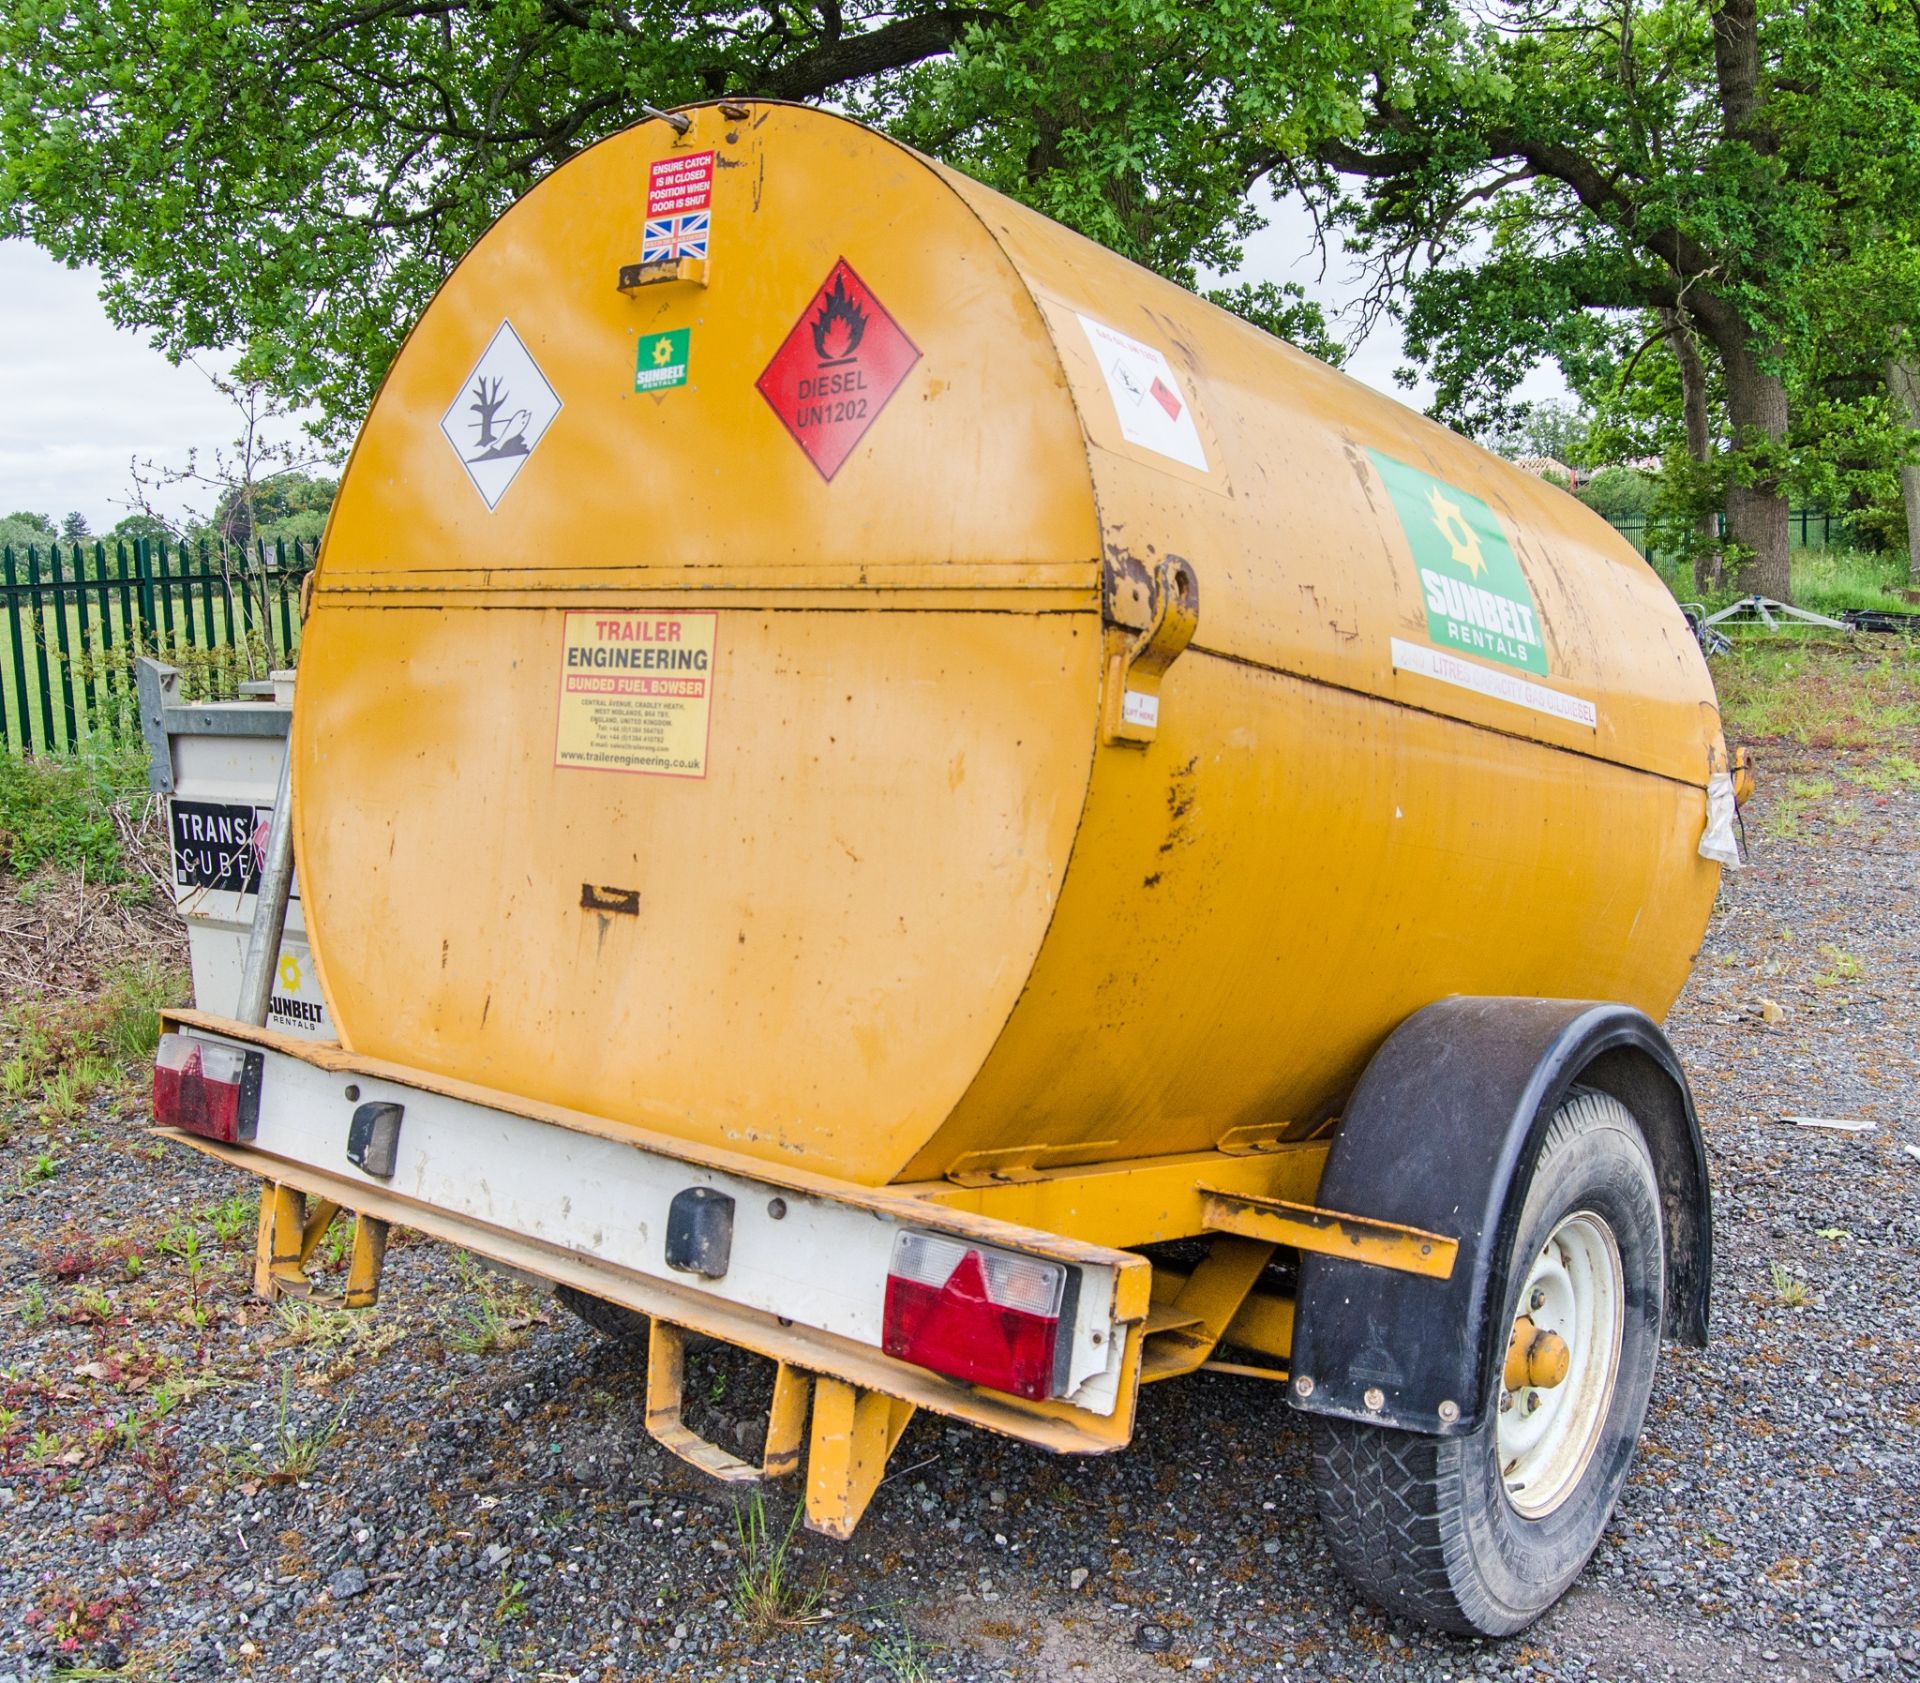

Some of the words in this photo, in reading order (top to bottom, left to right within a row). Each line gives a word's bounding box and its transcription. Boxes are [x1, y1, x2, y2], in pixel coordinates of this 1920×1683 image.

[653, 162, 683, 175] ENSURE
[685, 156, 711, 168] CATCH
[656, 177, 664, 187] IS
[666, 176, 674, 185] IN
[675, 169, 705, 183] CLOSED
[650, 186, 685, 200] POSITION
[687, 181, 710, 193] WHEN
[652, 201, 674, 212] DOOR
[676, 199, 684, 207] IS
[685, 194, 706, 206] SHUT
[798, 370, 867, 399] DIESEL
[796, 398, 867, 428] UN1202
[1420, 568, 1538, 645] SUNBELT
[596, 621, 681, 642] TRAILER
[1448, 621, 1527, 661] RENTALS
[567, 647, 708, 670] ENGINEERING
[568, 677, 615, 691] BUNDED
[618, 679, 648, 692] FUEL
[651, 680, 703, 695] BOWSER
[560, 751, 700, 769] www.trailerengineering.co.uk
[178, 813, 247, 845] TRANS
[184, 848, 249, 878] CUBE
[273, 1016, 315, 1030] RENTALS
